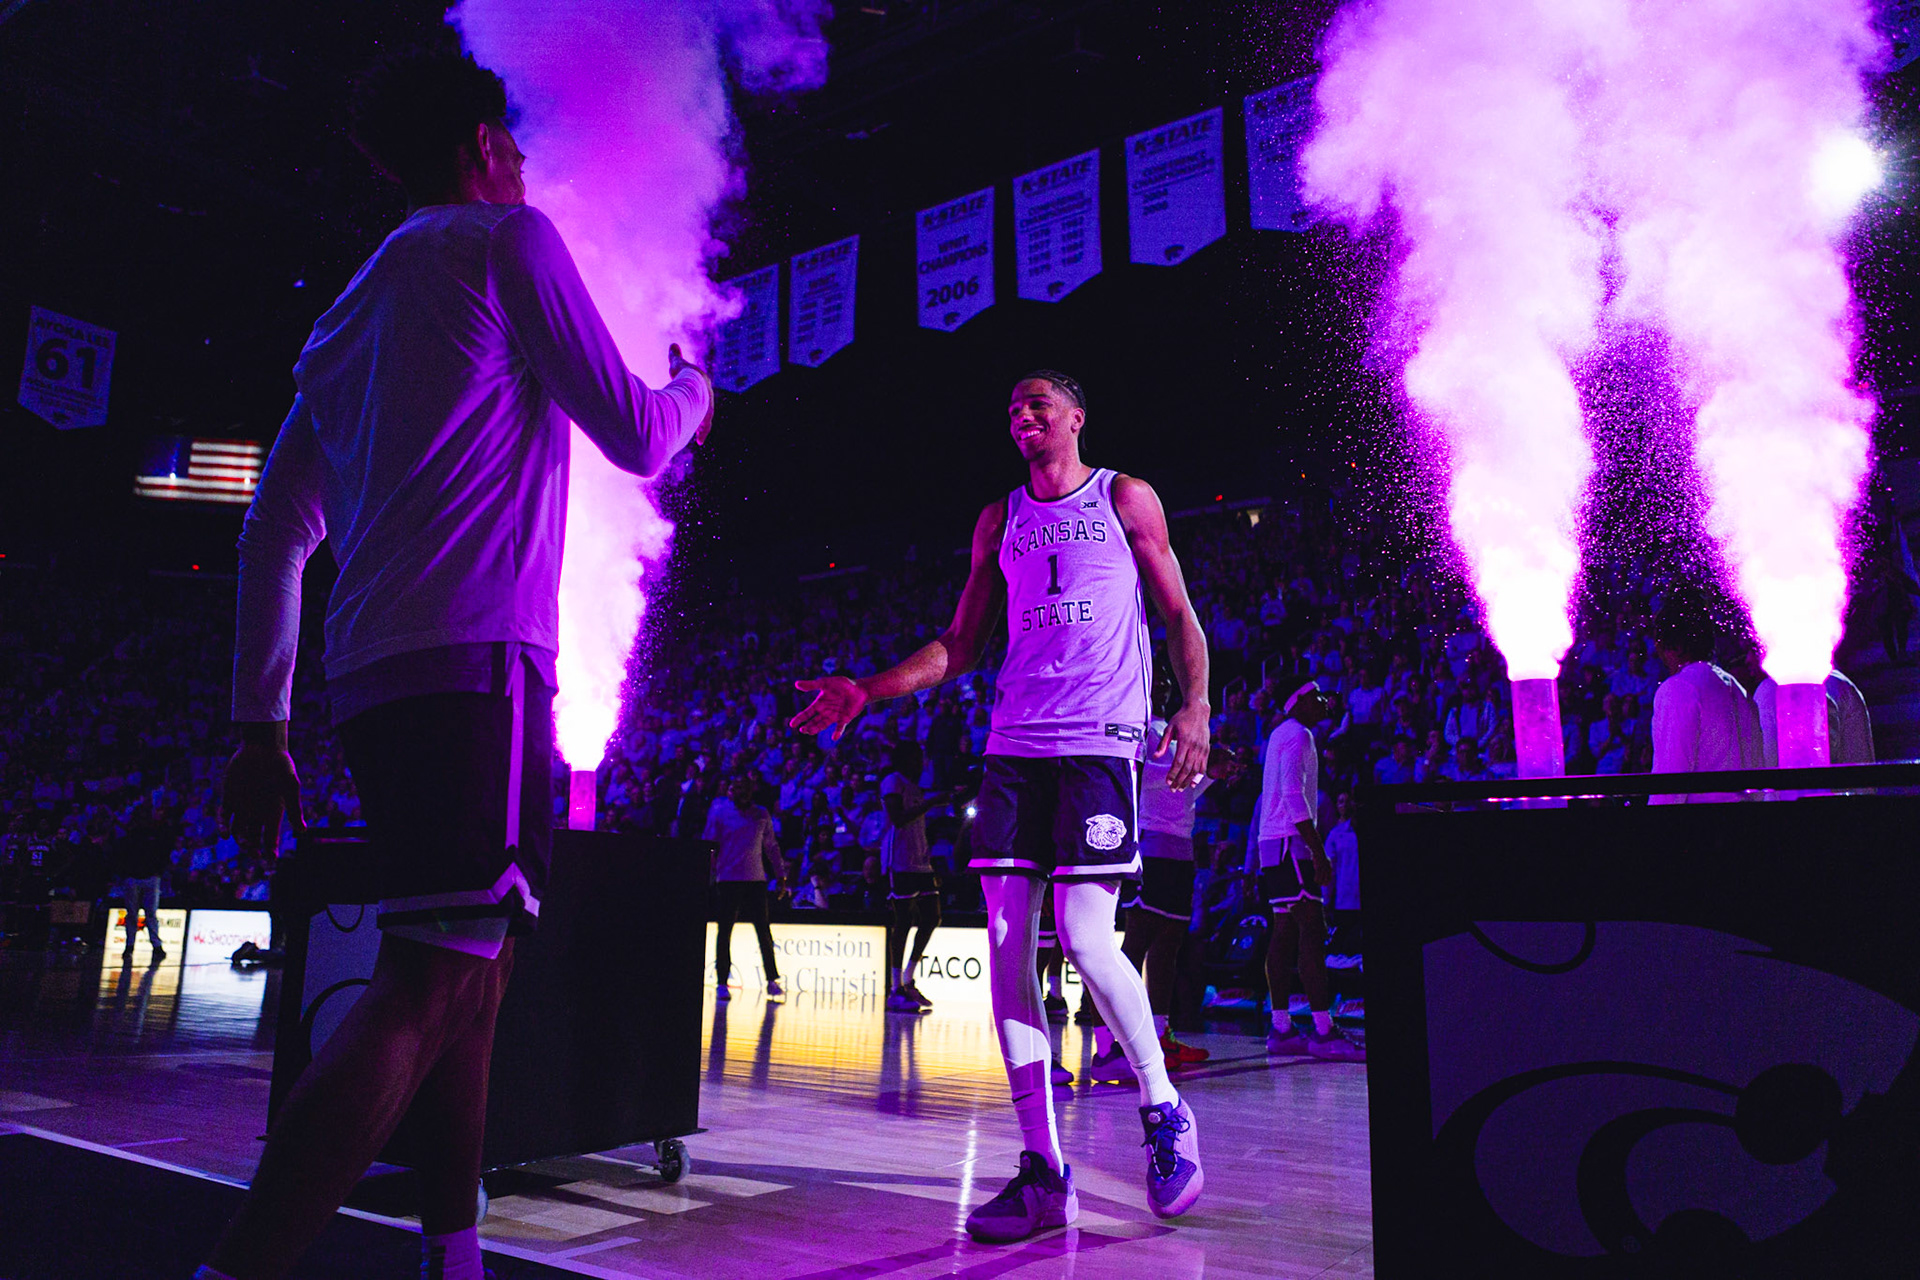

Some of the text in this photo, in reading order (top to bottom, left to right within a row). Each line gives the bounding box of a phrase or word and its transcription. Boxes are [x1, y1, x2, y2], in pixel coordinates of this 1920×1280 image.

[925, 275, 980, 309] 2006
[36, 338, 96, 389] 61
[1012, 519, 1107, 562] KANSAS
[1046, 553, 1062, 596] 1
[1022, 600, 1094, 632] STATE
[771, 932, 872, 958] scension
[796, 966, 877, 996] Christi
[917, 955, 982, 980] TACO
